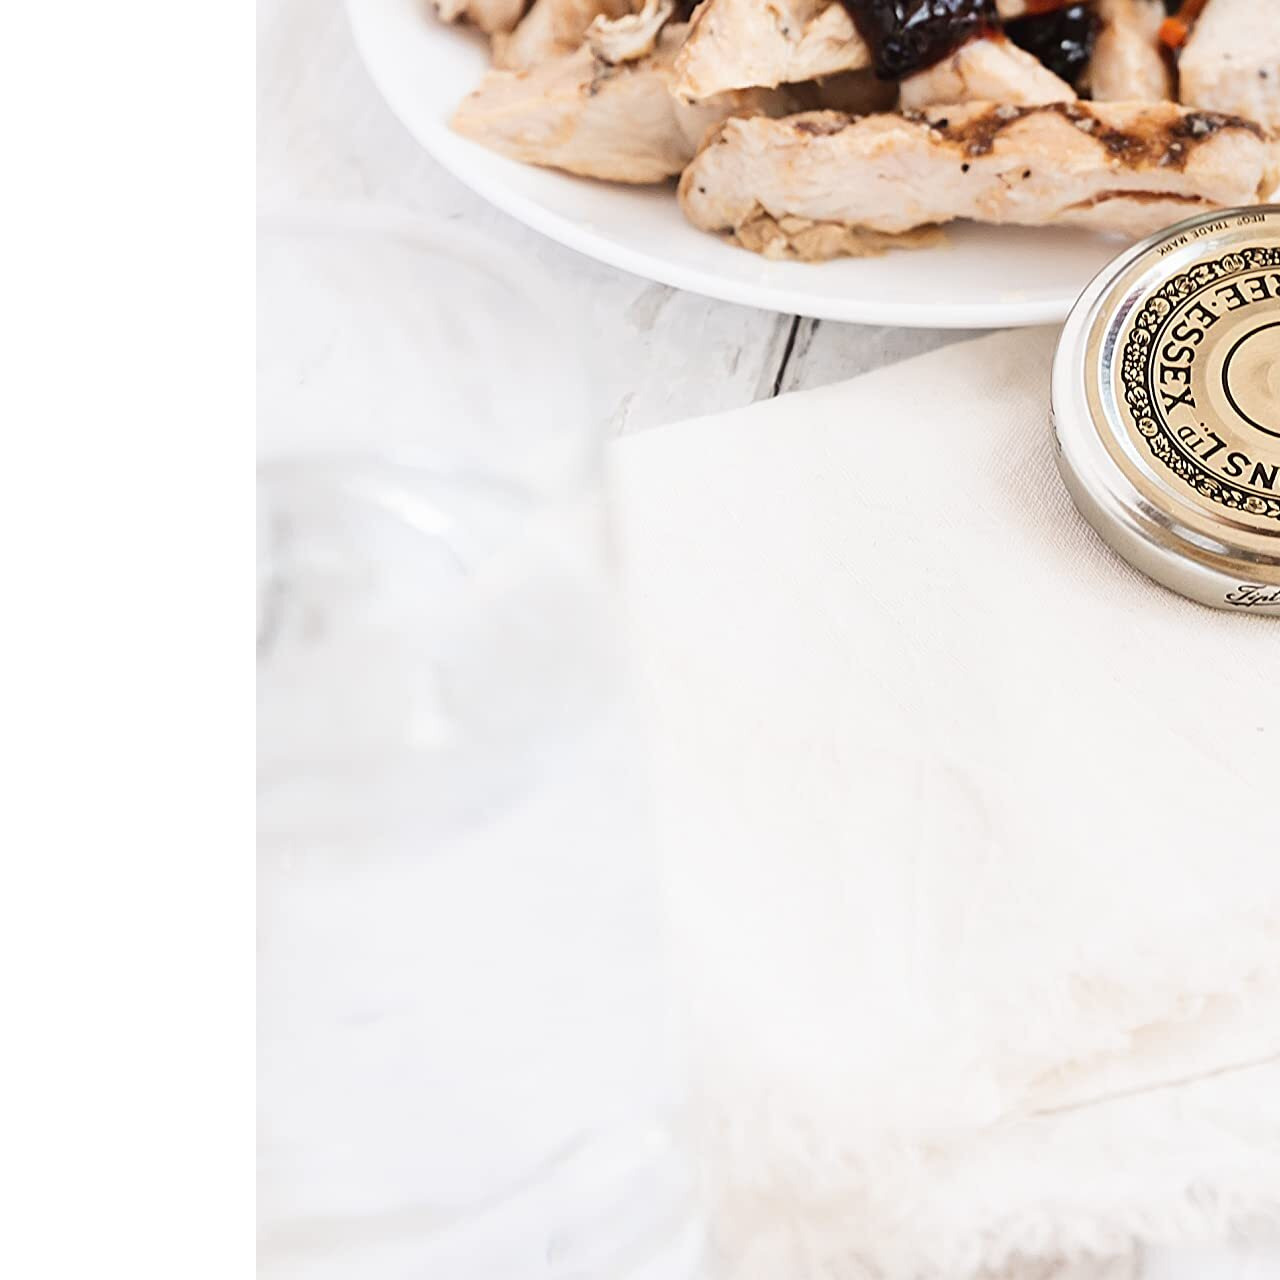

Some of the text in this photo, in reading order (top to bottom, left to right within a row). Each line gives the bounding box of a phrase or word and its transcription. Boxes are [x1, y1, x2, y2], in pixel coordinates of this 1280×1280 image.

[1191, 220, 1230, 240] TRADE
[1156, 234, 1189, 256] MARK
[1159, 299, 1220, 415] ESSEX
